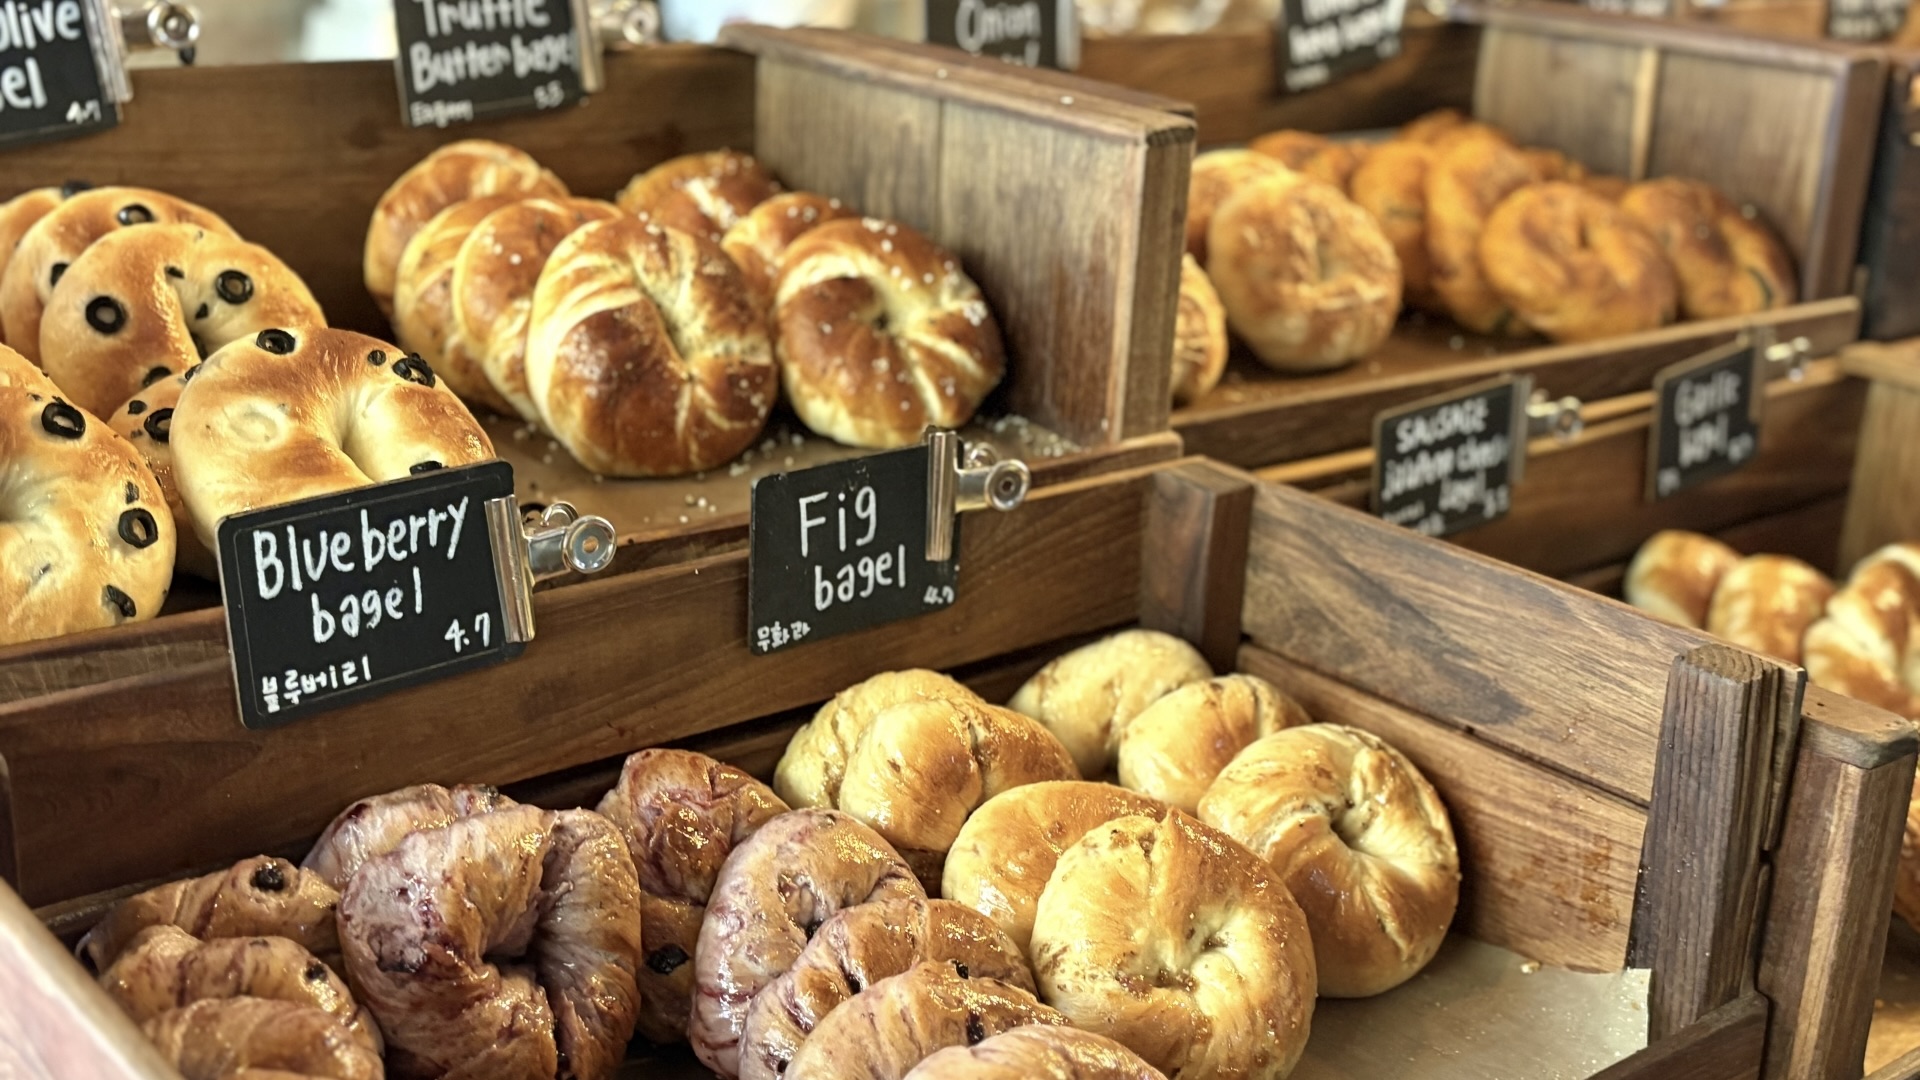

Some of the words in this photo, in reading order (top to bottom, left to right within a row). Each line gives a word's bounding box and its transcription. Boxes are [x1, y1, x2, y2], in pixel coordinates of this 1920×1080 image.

[410, 41, 511, 94] Butter
[252, 496, 468, 600] Blueberry
[798, 486, 877, 558] Fig
[311, 565, 423, 644] bagel
[814, 544, 906, 612] bagel
[922, 584, 955, 605] 4.7
[443, 611, 491, 653] 4.7
[261, 653, 371, 714] 블루베리
